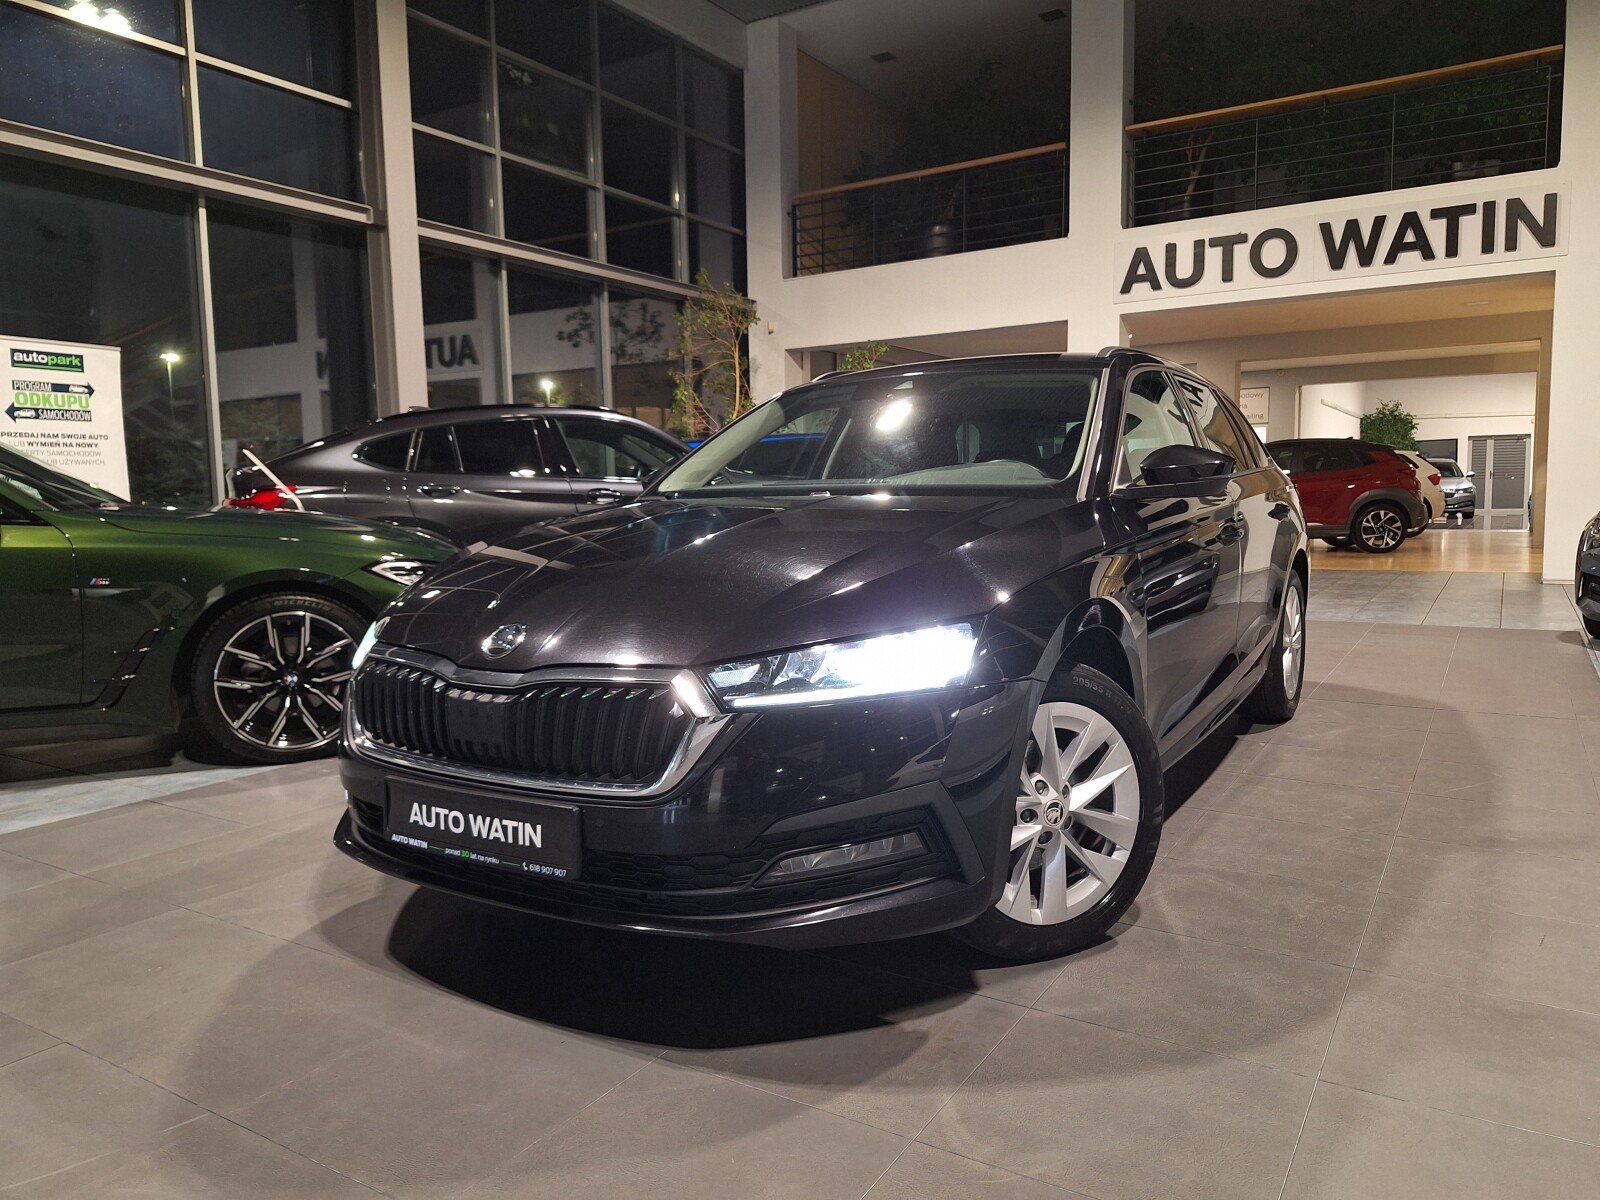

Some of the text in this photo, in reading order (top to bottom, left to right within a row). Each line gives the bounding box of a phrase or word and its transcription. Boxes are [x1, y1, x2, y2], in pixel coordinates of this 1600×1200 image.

[1119, 192, 1558, 294] AUTO WATIN
[13, 352, 81, 366] autopark
[14, 381, 52, 392] PROGRAM
[14, 391, 90, 409] ODKUPU
[38, 409, 92, 421] SAMOCHODÓW
[27, 440, 60, 448] WYMIEŃ
[46, 449, 101, 457] SAMOCHODÓW
[1072, 676, 1104, 693] 205/55
[409, 802, 542, 848] AUTO WATIN
[391, 833, 408, 844] AUTO
[408, 838, 428, 849] WATIN
[529, 863, 567, 877] 618 907 907
